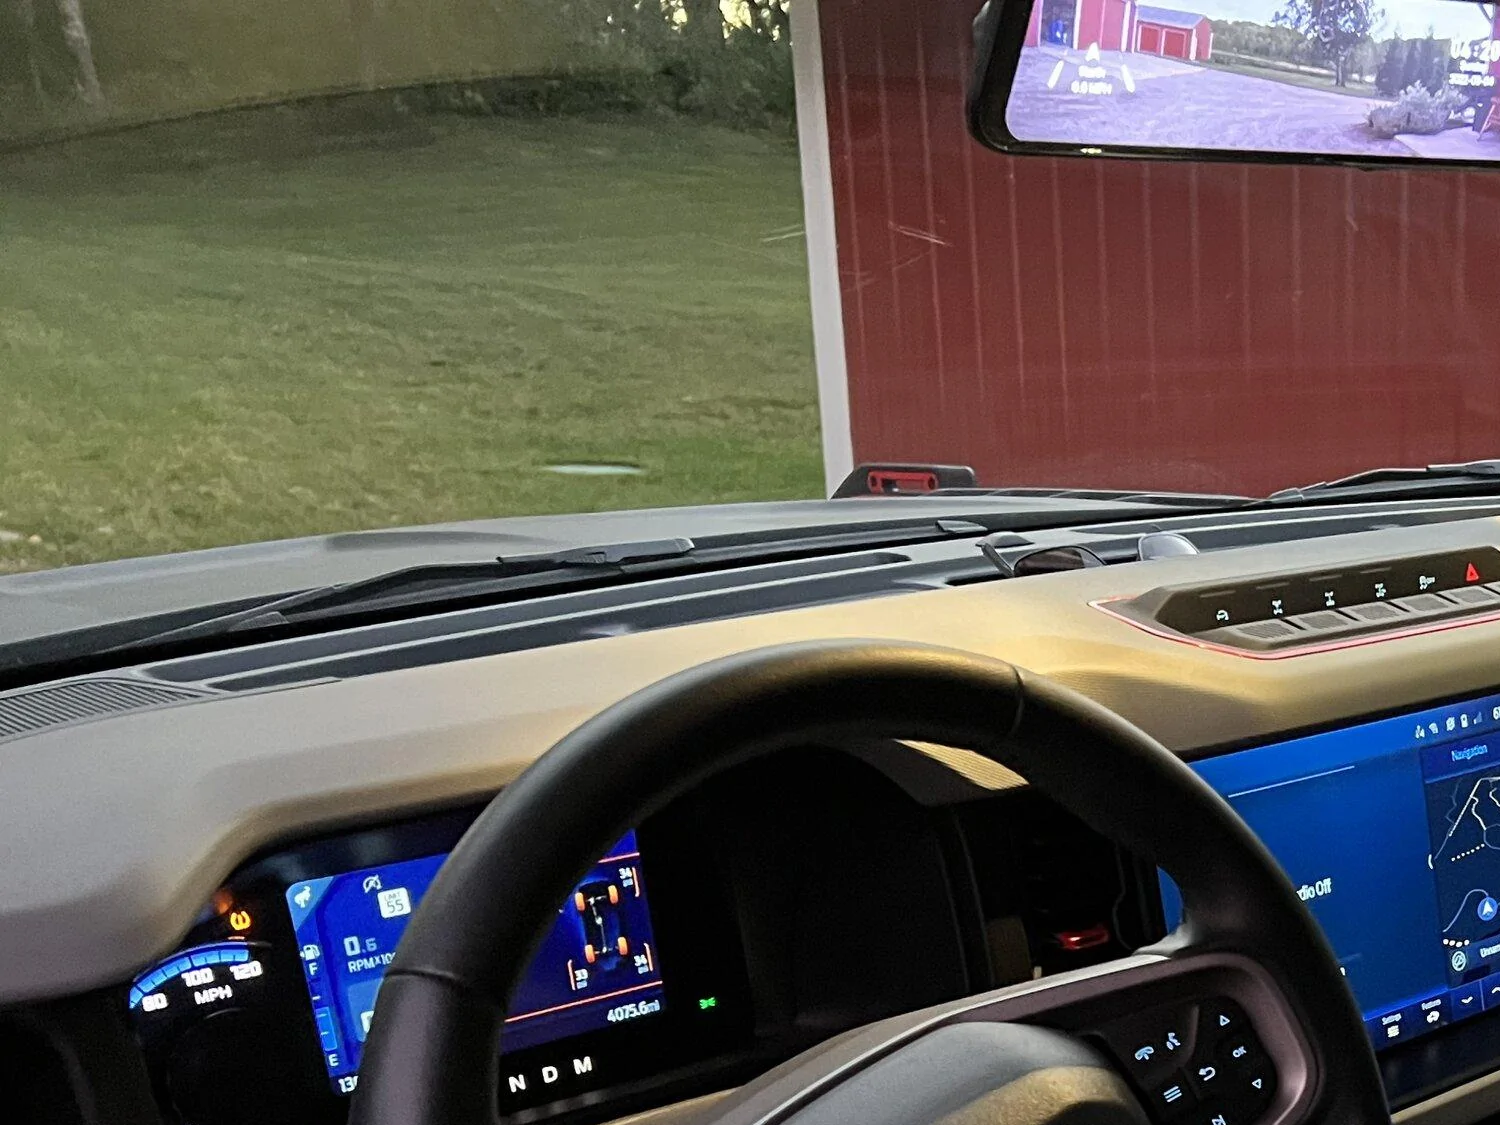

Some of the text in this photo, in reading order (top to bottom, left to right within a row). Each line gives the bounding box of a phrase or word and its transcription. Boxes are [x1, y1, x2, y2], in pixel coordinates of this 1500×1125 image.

[1451, 744, 1489, 762] Navigation
[1296, 884, 1316, 901] dio
[386, 899, 405, 914] 55
[181, 967, 214, 987] 100
[229, 960, 263, 980] 120
[308, 962, 318, 976] F
[141, 993, 168, 1012] 80
[194, 984, 233, 1004] MPH
[328, 1053, 339, 1067] E
[1232, 1046, 1247, 1058] OK
[507, 1055, 593, 1093] N D M
[338, 1075, 359, 1093] 13
